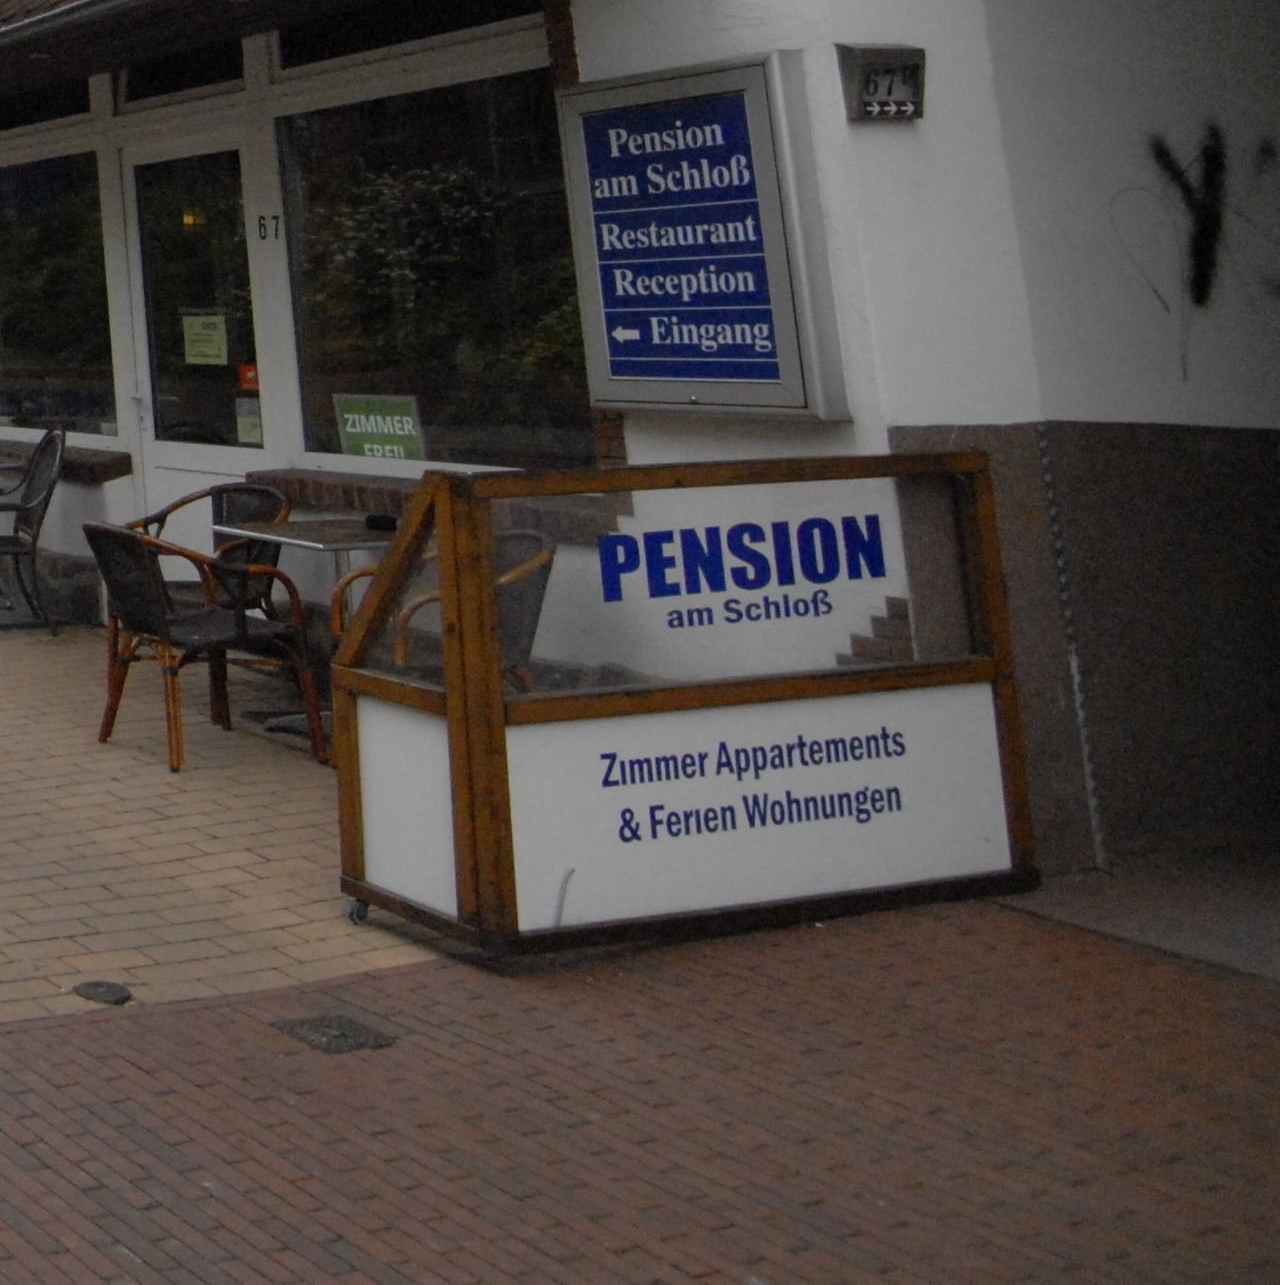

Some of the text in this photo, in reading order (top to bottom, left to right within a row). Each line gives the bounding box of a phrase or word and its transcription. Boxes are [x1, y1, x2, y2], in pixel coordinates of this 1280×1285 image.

[608, 120, 724, 157] Pension
[594, 154, 751, 199] am Schloß
[258, 215, 280, 240] 67
[600, 214, 757, 251] Restaurant
[612, 265, 756, 302] Reception
[650, 316, 772, 353] Eingang
[343, 414, 416, 435] ZIMMER
[597, 514, 887, 603] PENSION
[666, 589, 833, 629] am Schloß
[600, 726, 907, 788] Zimmer Appartements
[618, 786, 903, 843] & Ferien Wohnungen
